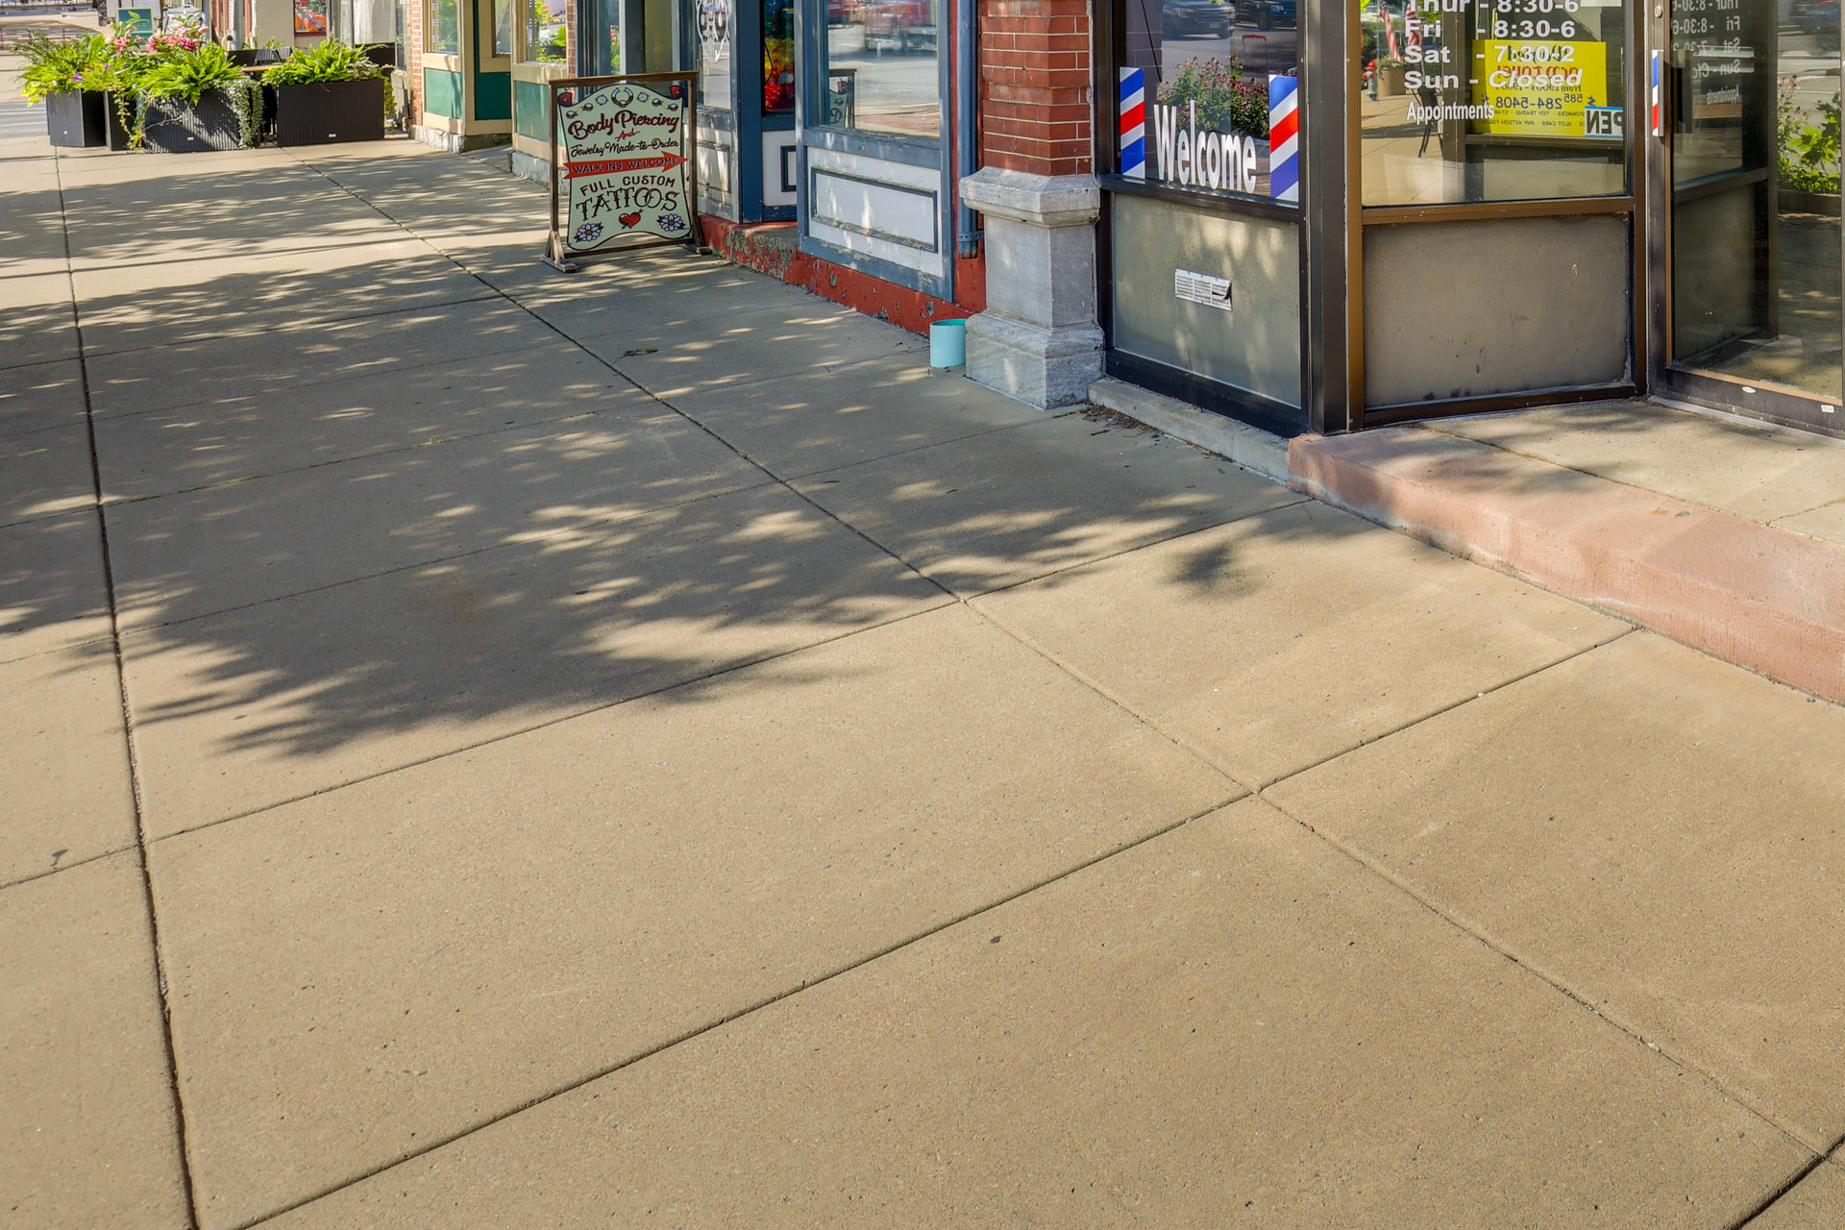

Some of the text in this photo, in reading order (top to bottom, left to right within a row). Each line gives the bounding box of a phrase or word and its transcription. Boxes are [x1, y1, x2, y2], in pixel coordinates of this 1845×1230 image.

[1404, 19, 1442, 38] Fri
[1493, 20, 1576, 38] 8:30-6
[1403, 44, 1451, 64] Sat
[1493, 44, 1576, 63] 7:30-2
[1403, 70, 1460, 89] Sun
[1487, 68, 1583, 88] Closed
[1406, 101, 1496, 126] Appointments
[568, 109, 680, 140] Body Piercing
[614, 128, 640, 142] And
[570, 143, 606, 158] Jewelry
[1153, 99, 1258, 194] Welcome
[573, 156, 679, 174] WALK INS WELCOME
[580, 175, 676, 197] FULL CUSTOM
[575, 187, 680, 222] TATTOOS
